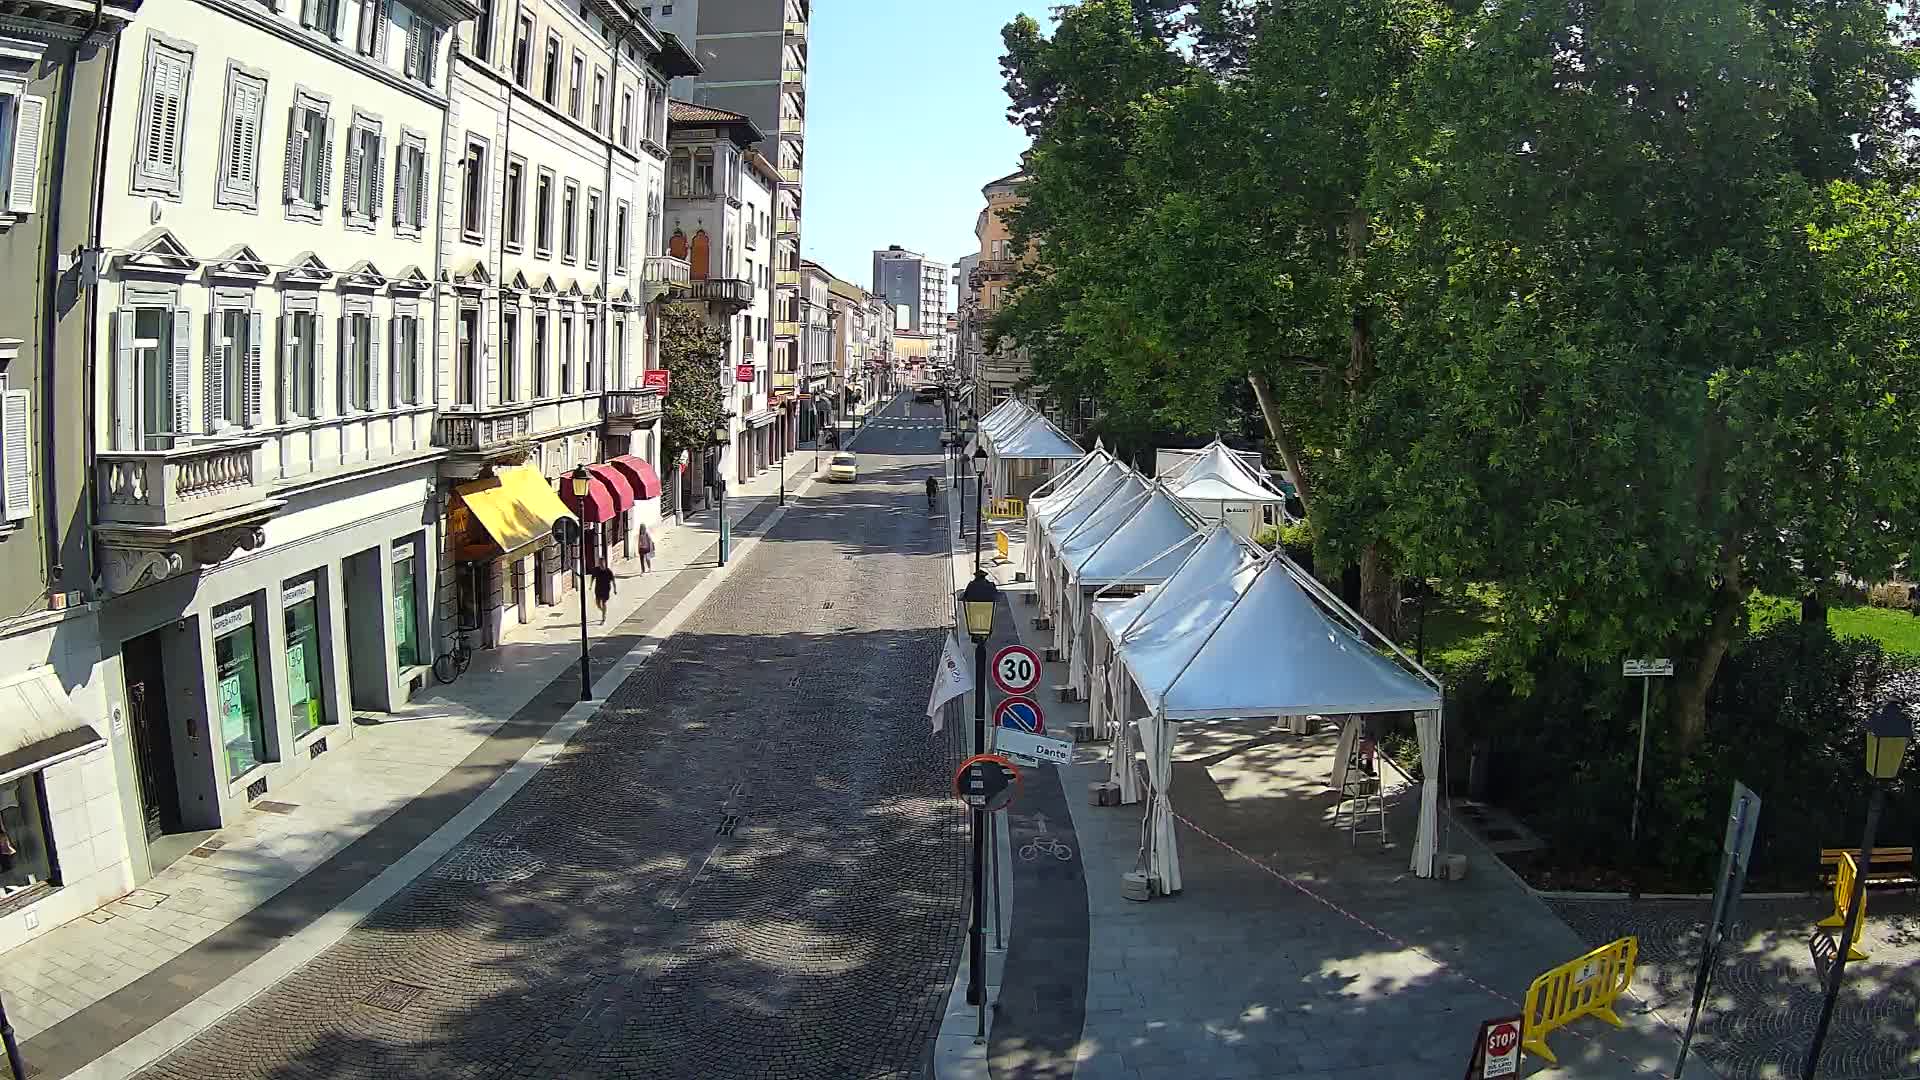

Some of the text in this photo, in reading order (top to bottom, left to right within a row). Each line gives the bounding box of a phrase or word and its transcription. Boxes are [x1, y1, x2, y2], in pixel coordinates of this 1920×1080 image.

[1004, 659, 1032, 681] 30
[1036, 745, 1066, 759] Dante
[1489, 1031, 1516, 1049] STOP
